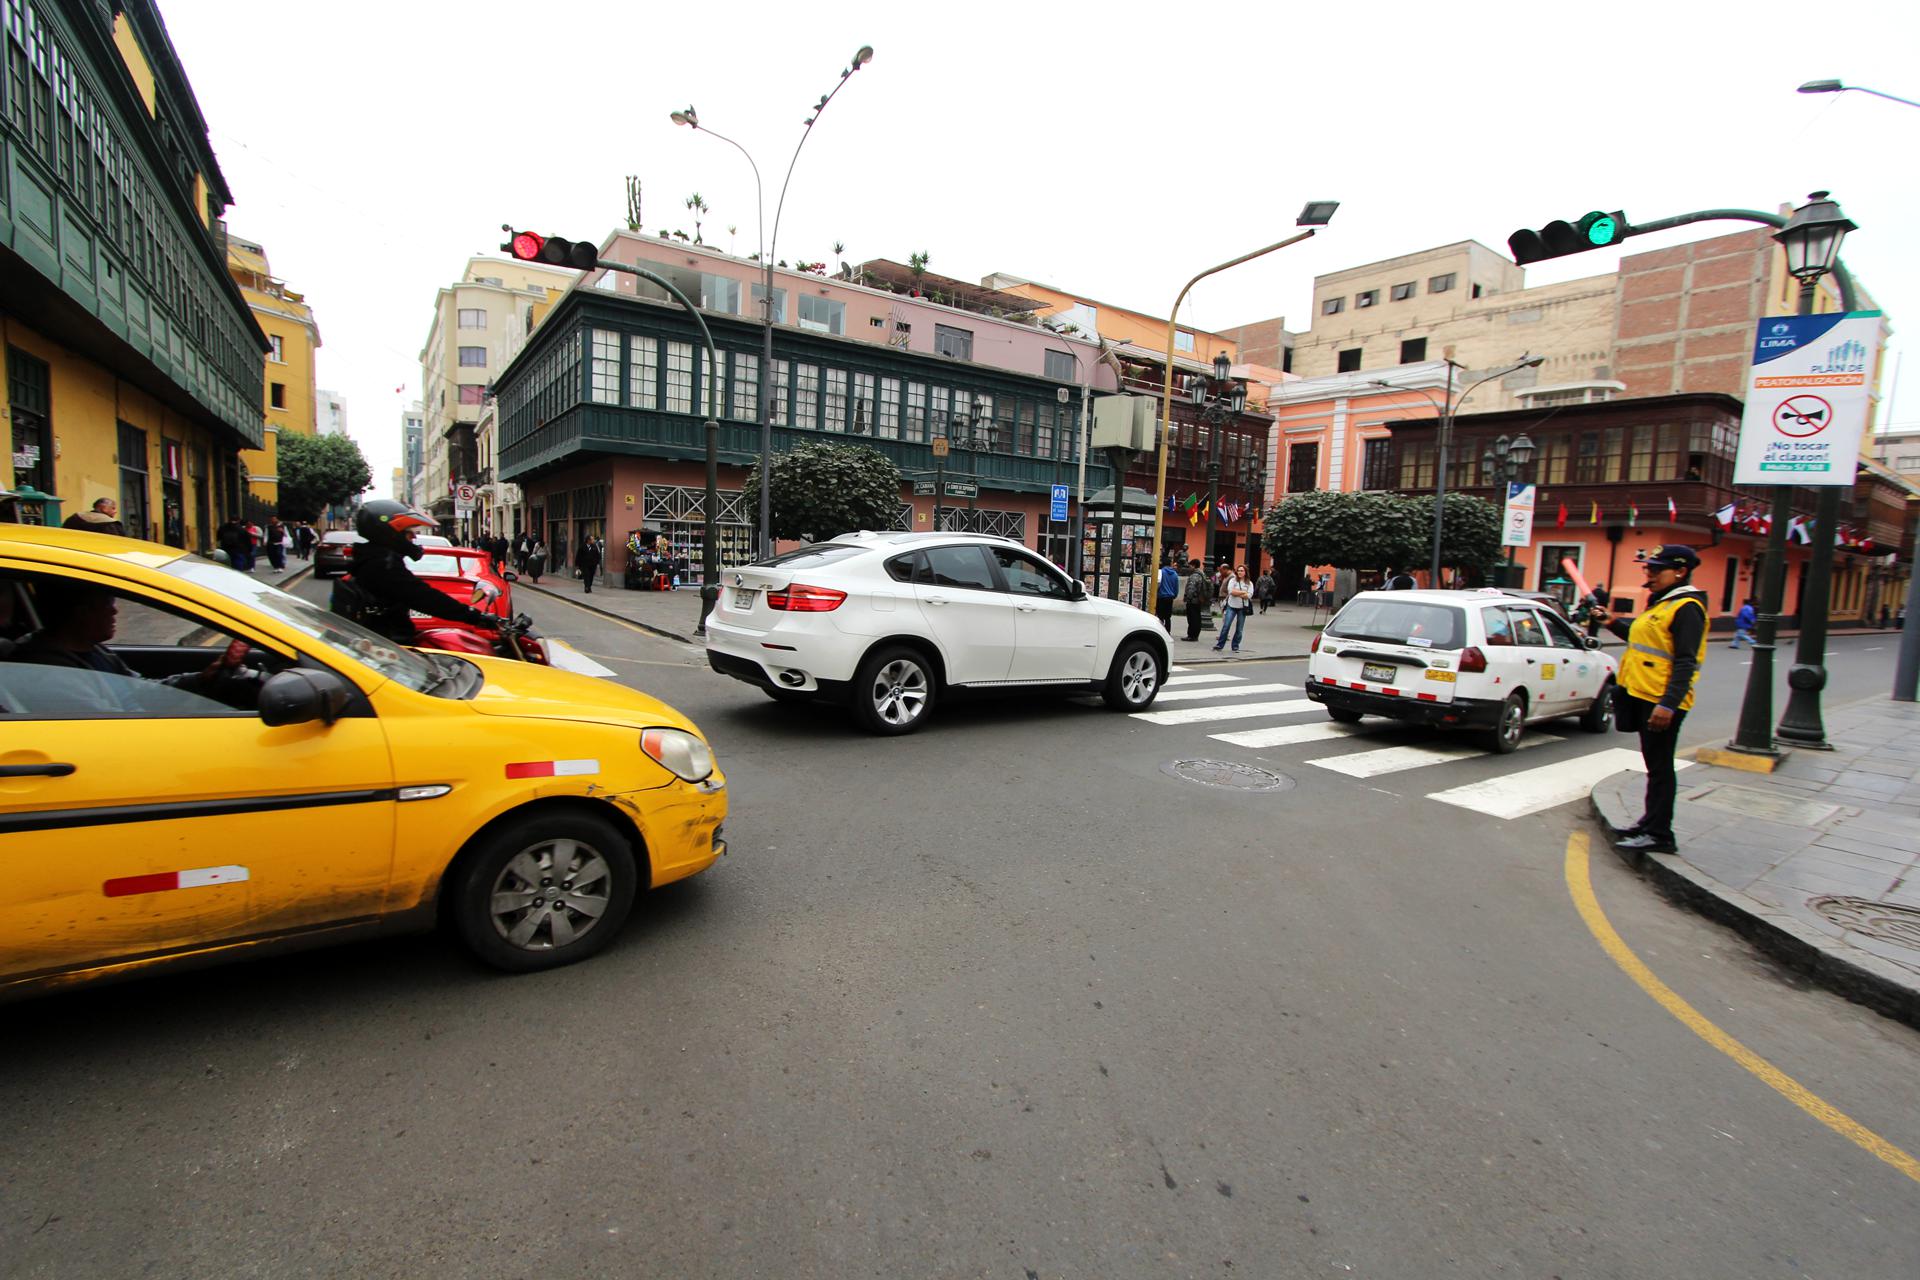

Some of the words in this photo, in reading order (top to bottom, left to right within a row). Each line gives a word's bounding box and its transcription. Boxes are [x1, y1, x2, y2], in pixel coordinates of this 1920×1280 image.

[1759, 339, 1796, 348] LIMA
[1811, 364, 1844, 373] PLAN
[1848, 363, 1864, 373] DE
[1794, 442, 1830, 451] tocar
[1764, 453, 1776, 462] el
